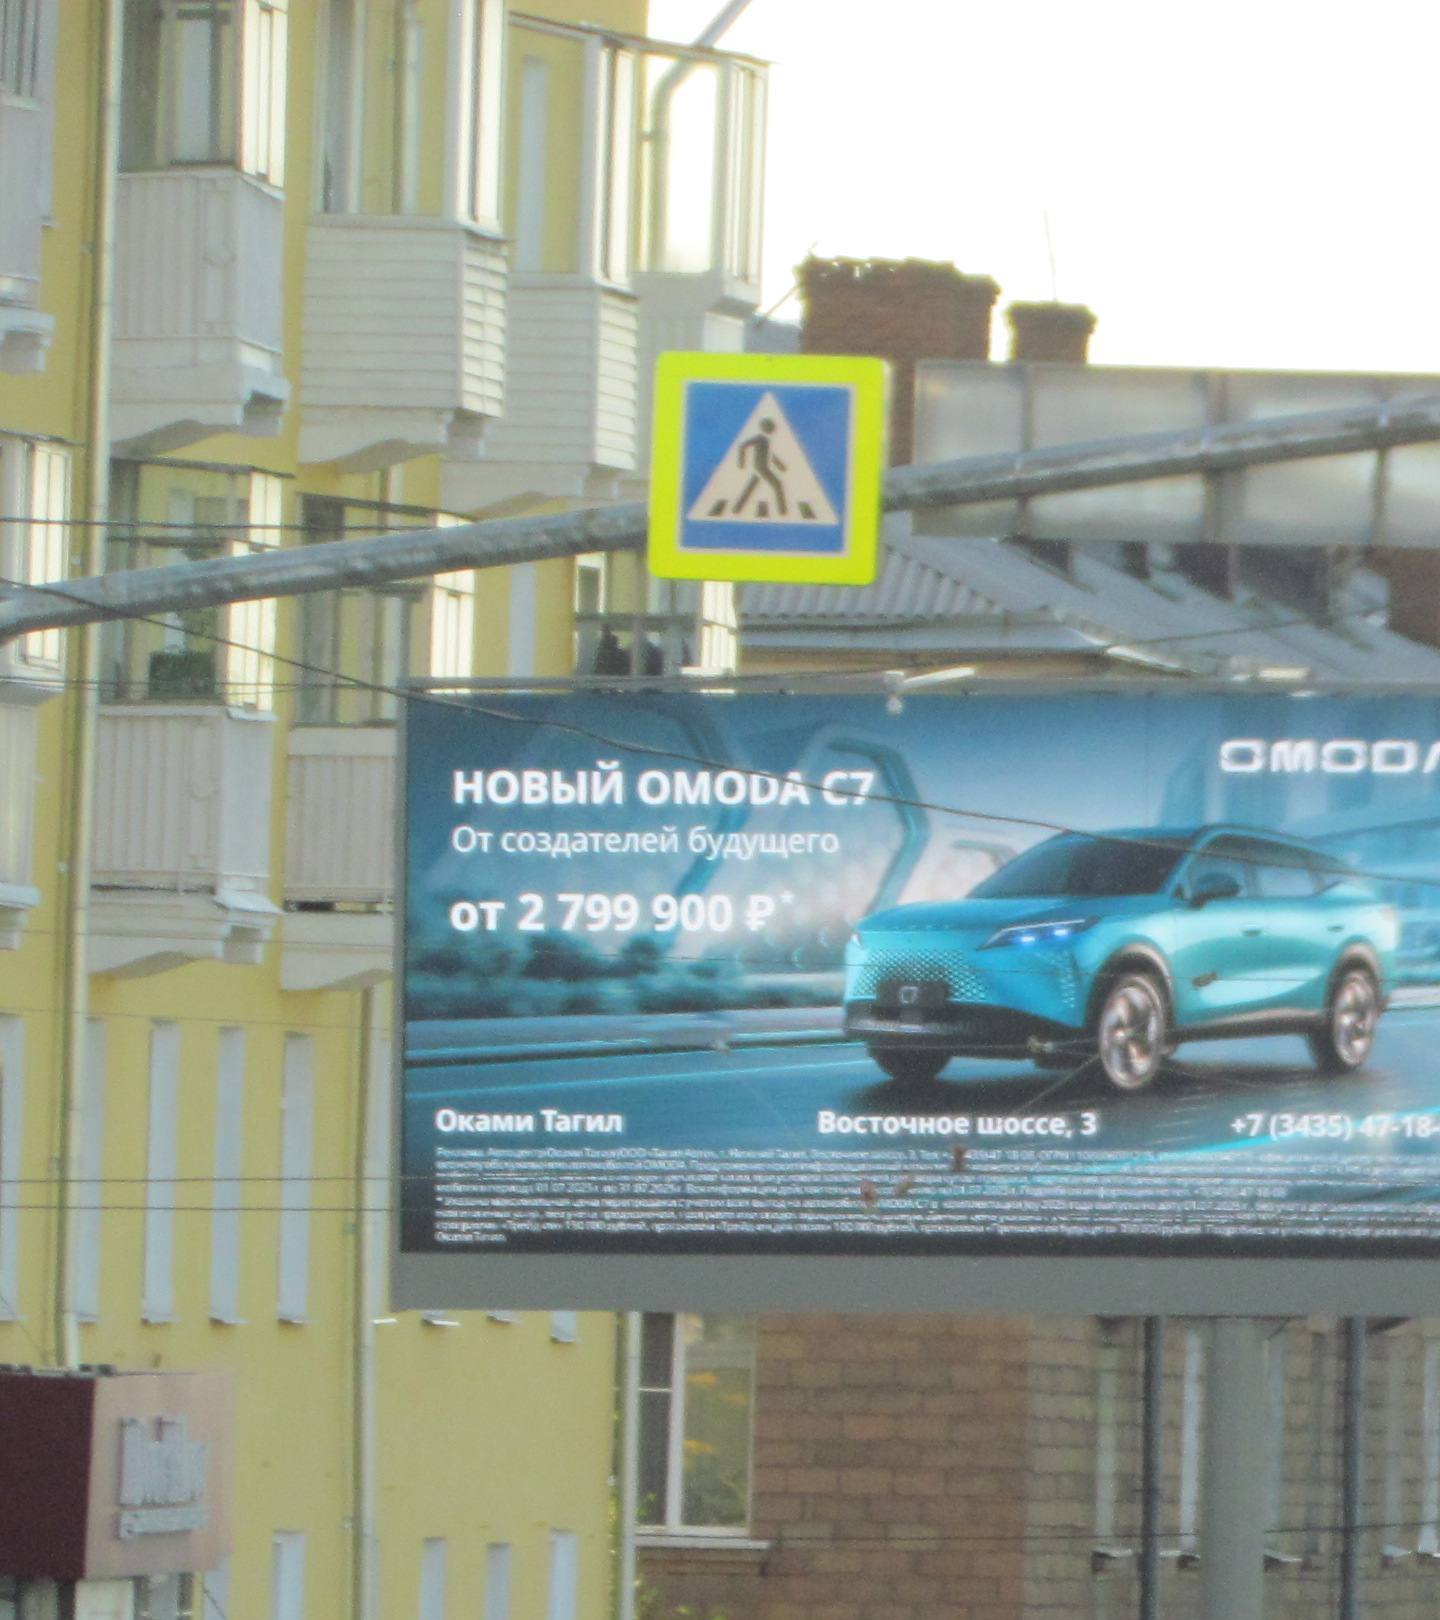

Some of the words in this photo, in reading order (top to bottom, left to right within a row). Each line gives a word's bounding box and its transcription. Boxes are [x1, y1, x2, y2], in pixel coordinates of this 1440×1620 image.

[453, 761, 623, 805] НОВЫЙ
[637, 771, 810, 806] OMODA
[452, 826, 495, 854] От
[501, 826, 679, 859] создателей
[688, 825, 839, 859] будущего
[450, 900, 505, 932] от
[517, 895, 545, 932] 2
[557, 896, 639, 932] 799
[651, 896, 734, 932] 900
[435, 1109, 535, 1133] Оками
[540, 1109, 624, 1133] Тагил
[818, 1111, 969, 1137] Восточное
[977, 1117, 1073, 1139] шоссе,
[1080, 1112, 1098, 1136] 3
[1231, 1114, 1264, 1137] +7
[1269, 1113, 1353, 1140] (3435)
